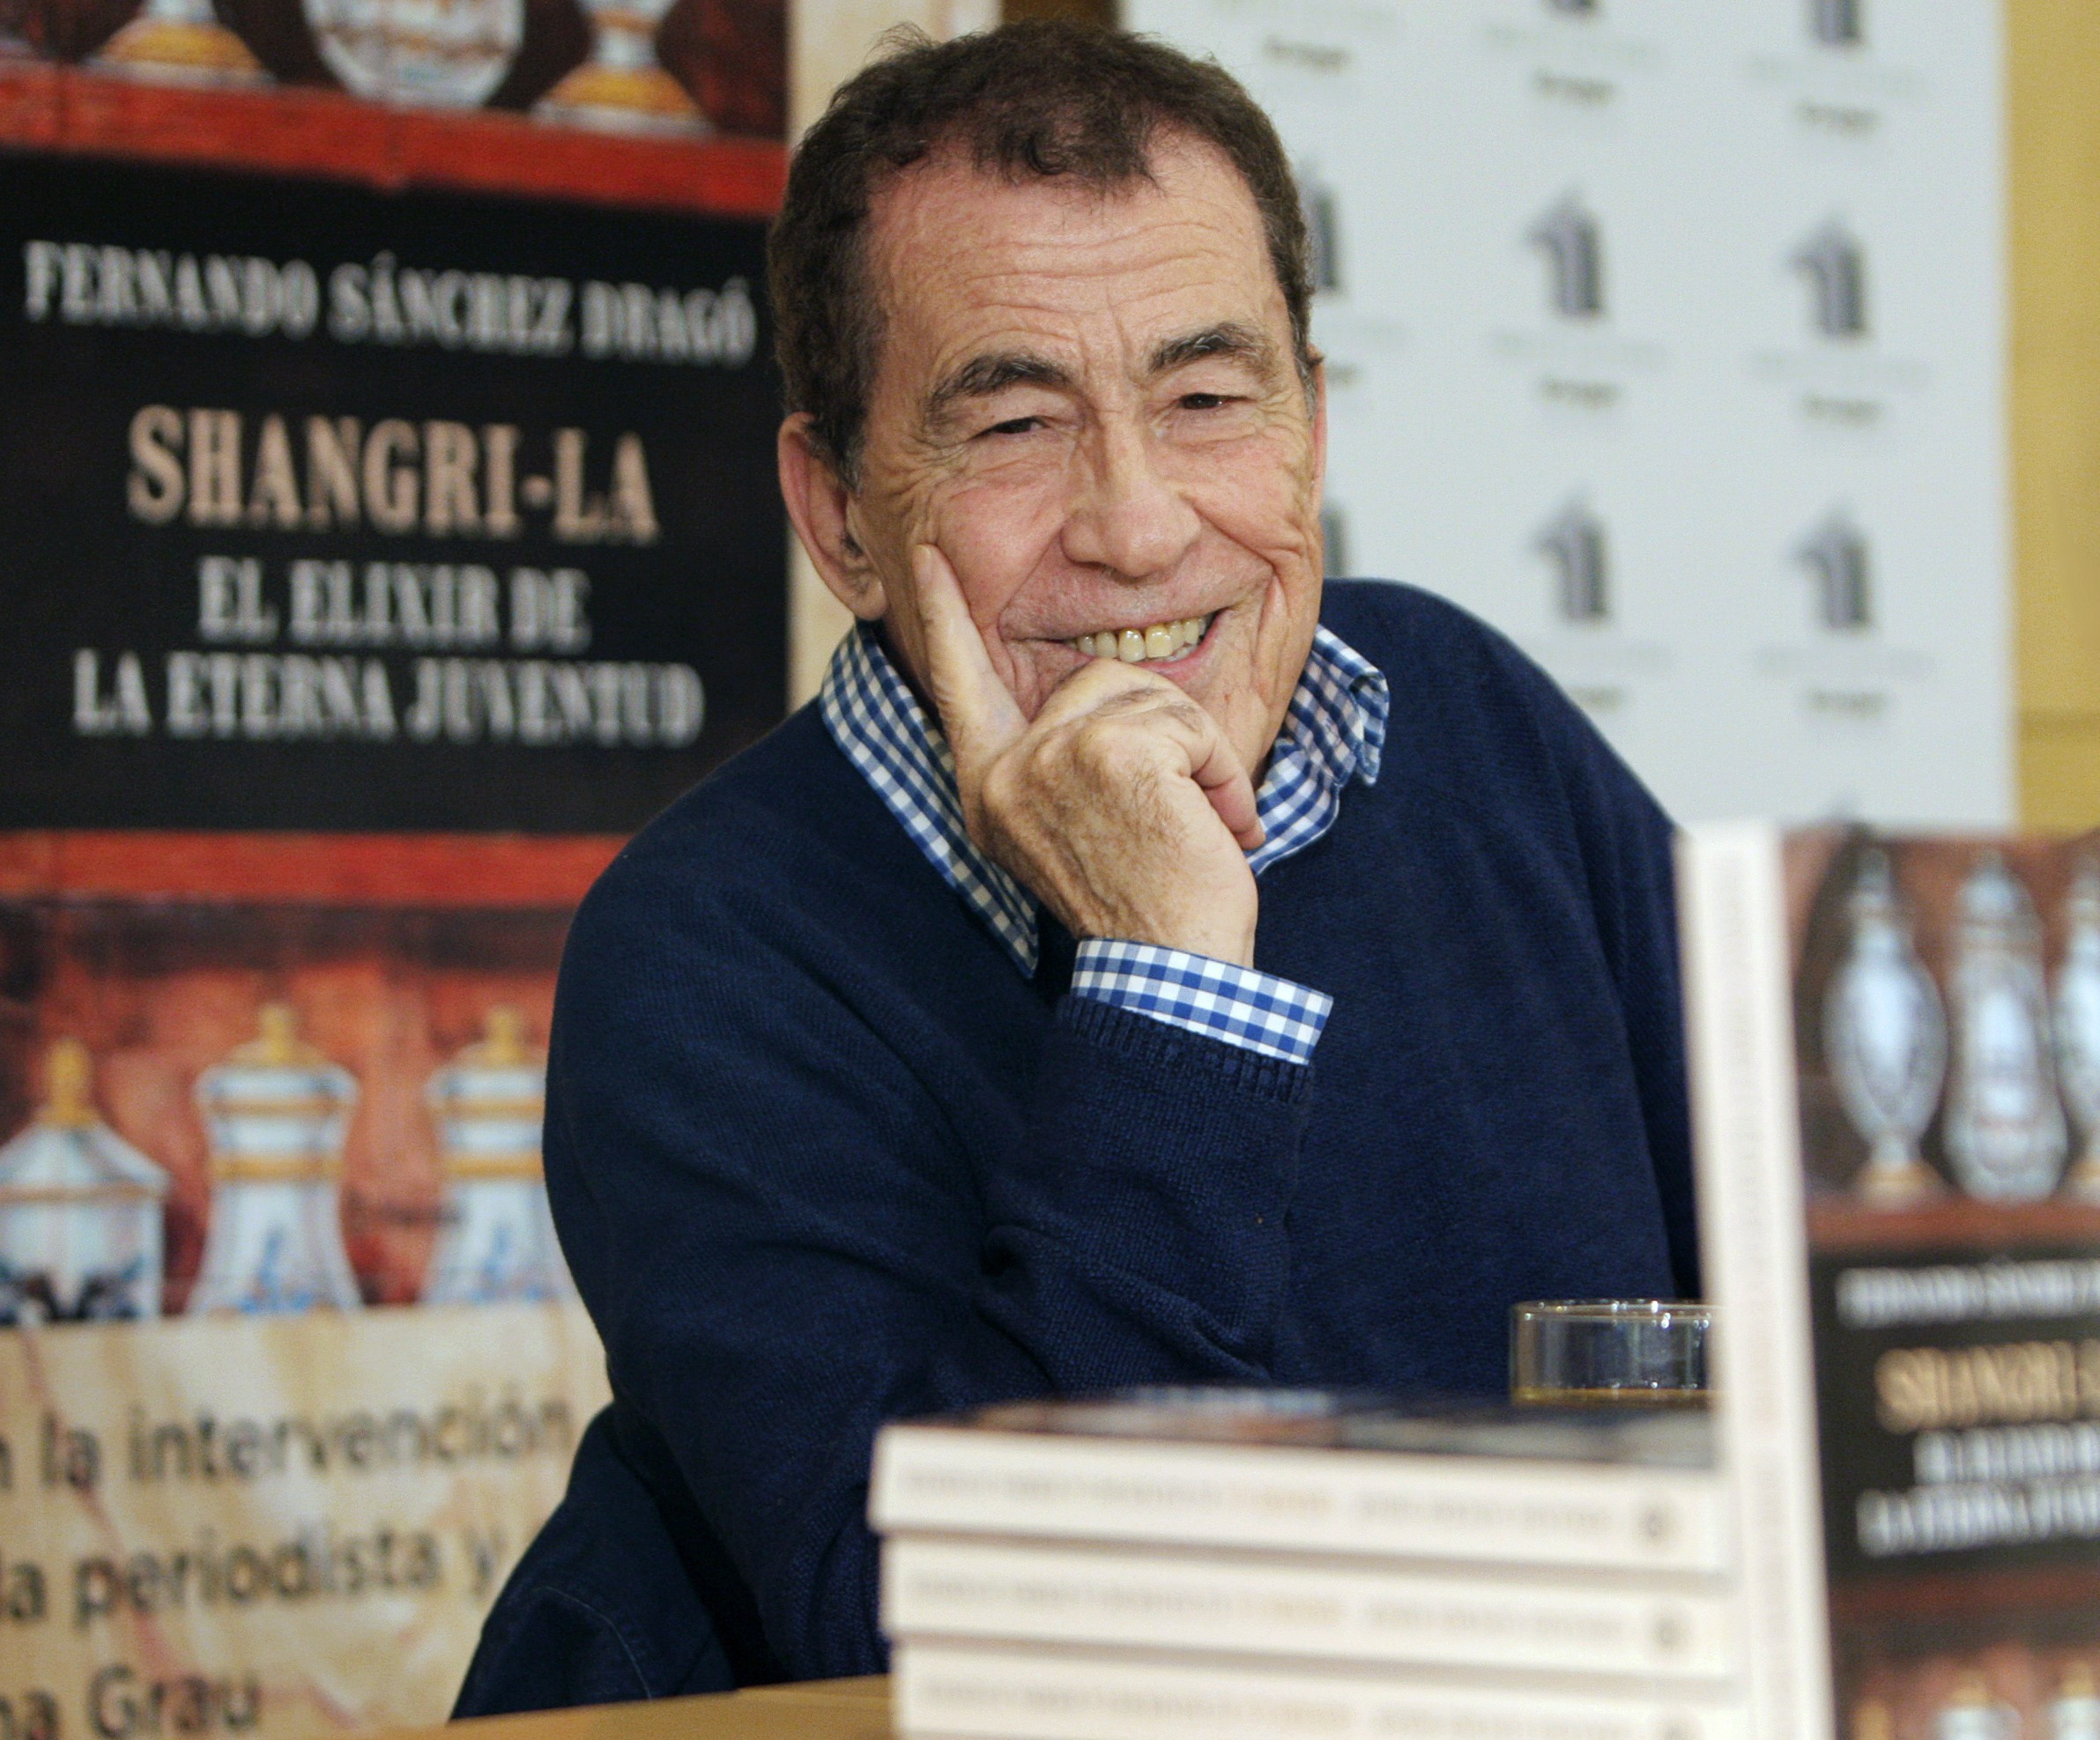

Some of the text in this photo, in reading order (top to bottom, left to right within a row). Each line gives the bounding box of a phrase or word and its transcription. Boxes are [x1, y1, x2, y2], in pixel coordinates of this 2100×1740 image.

[24, 241, 757, 366] FERNANDO SÁNCHEZ DRAGÓ
[128, 404, 659, 544] SHANGRI-LA
[197, 556, 590, 654] EL ELIXIR DE
[73, 648, 705, 746] LA ETERNA JUVENTUD
[42, 1411, 101, 1491] la
[129, 1385, 572, 1484] intervención
[73, 1522, 441, 1630] periodista
[463, 1526, 506, 1602] y
[89, 1665, 263, 1740] Grau
